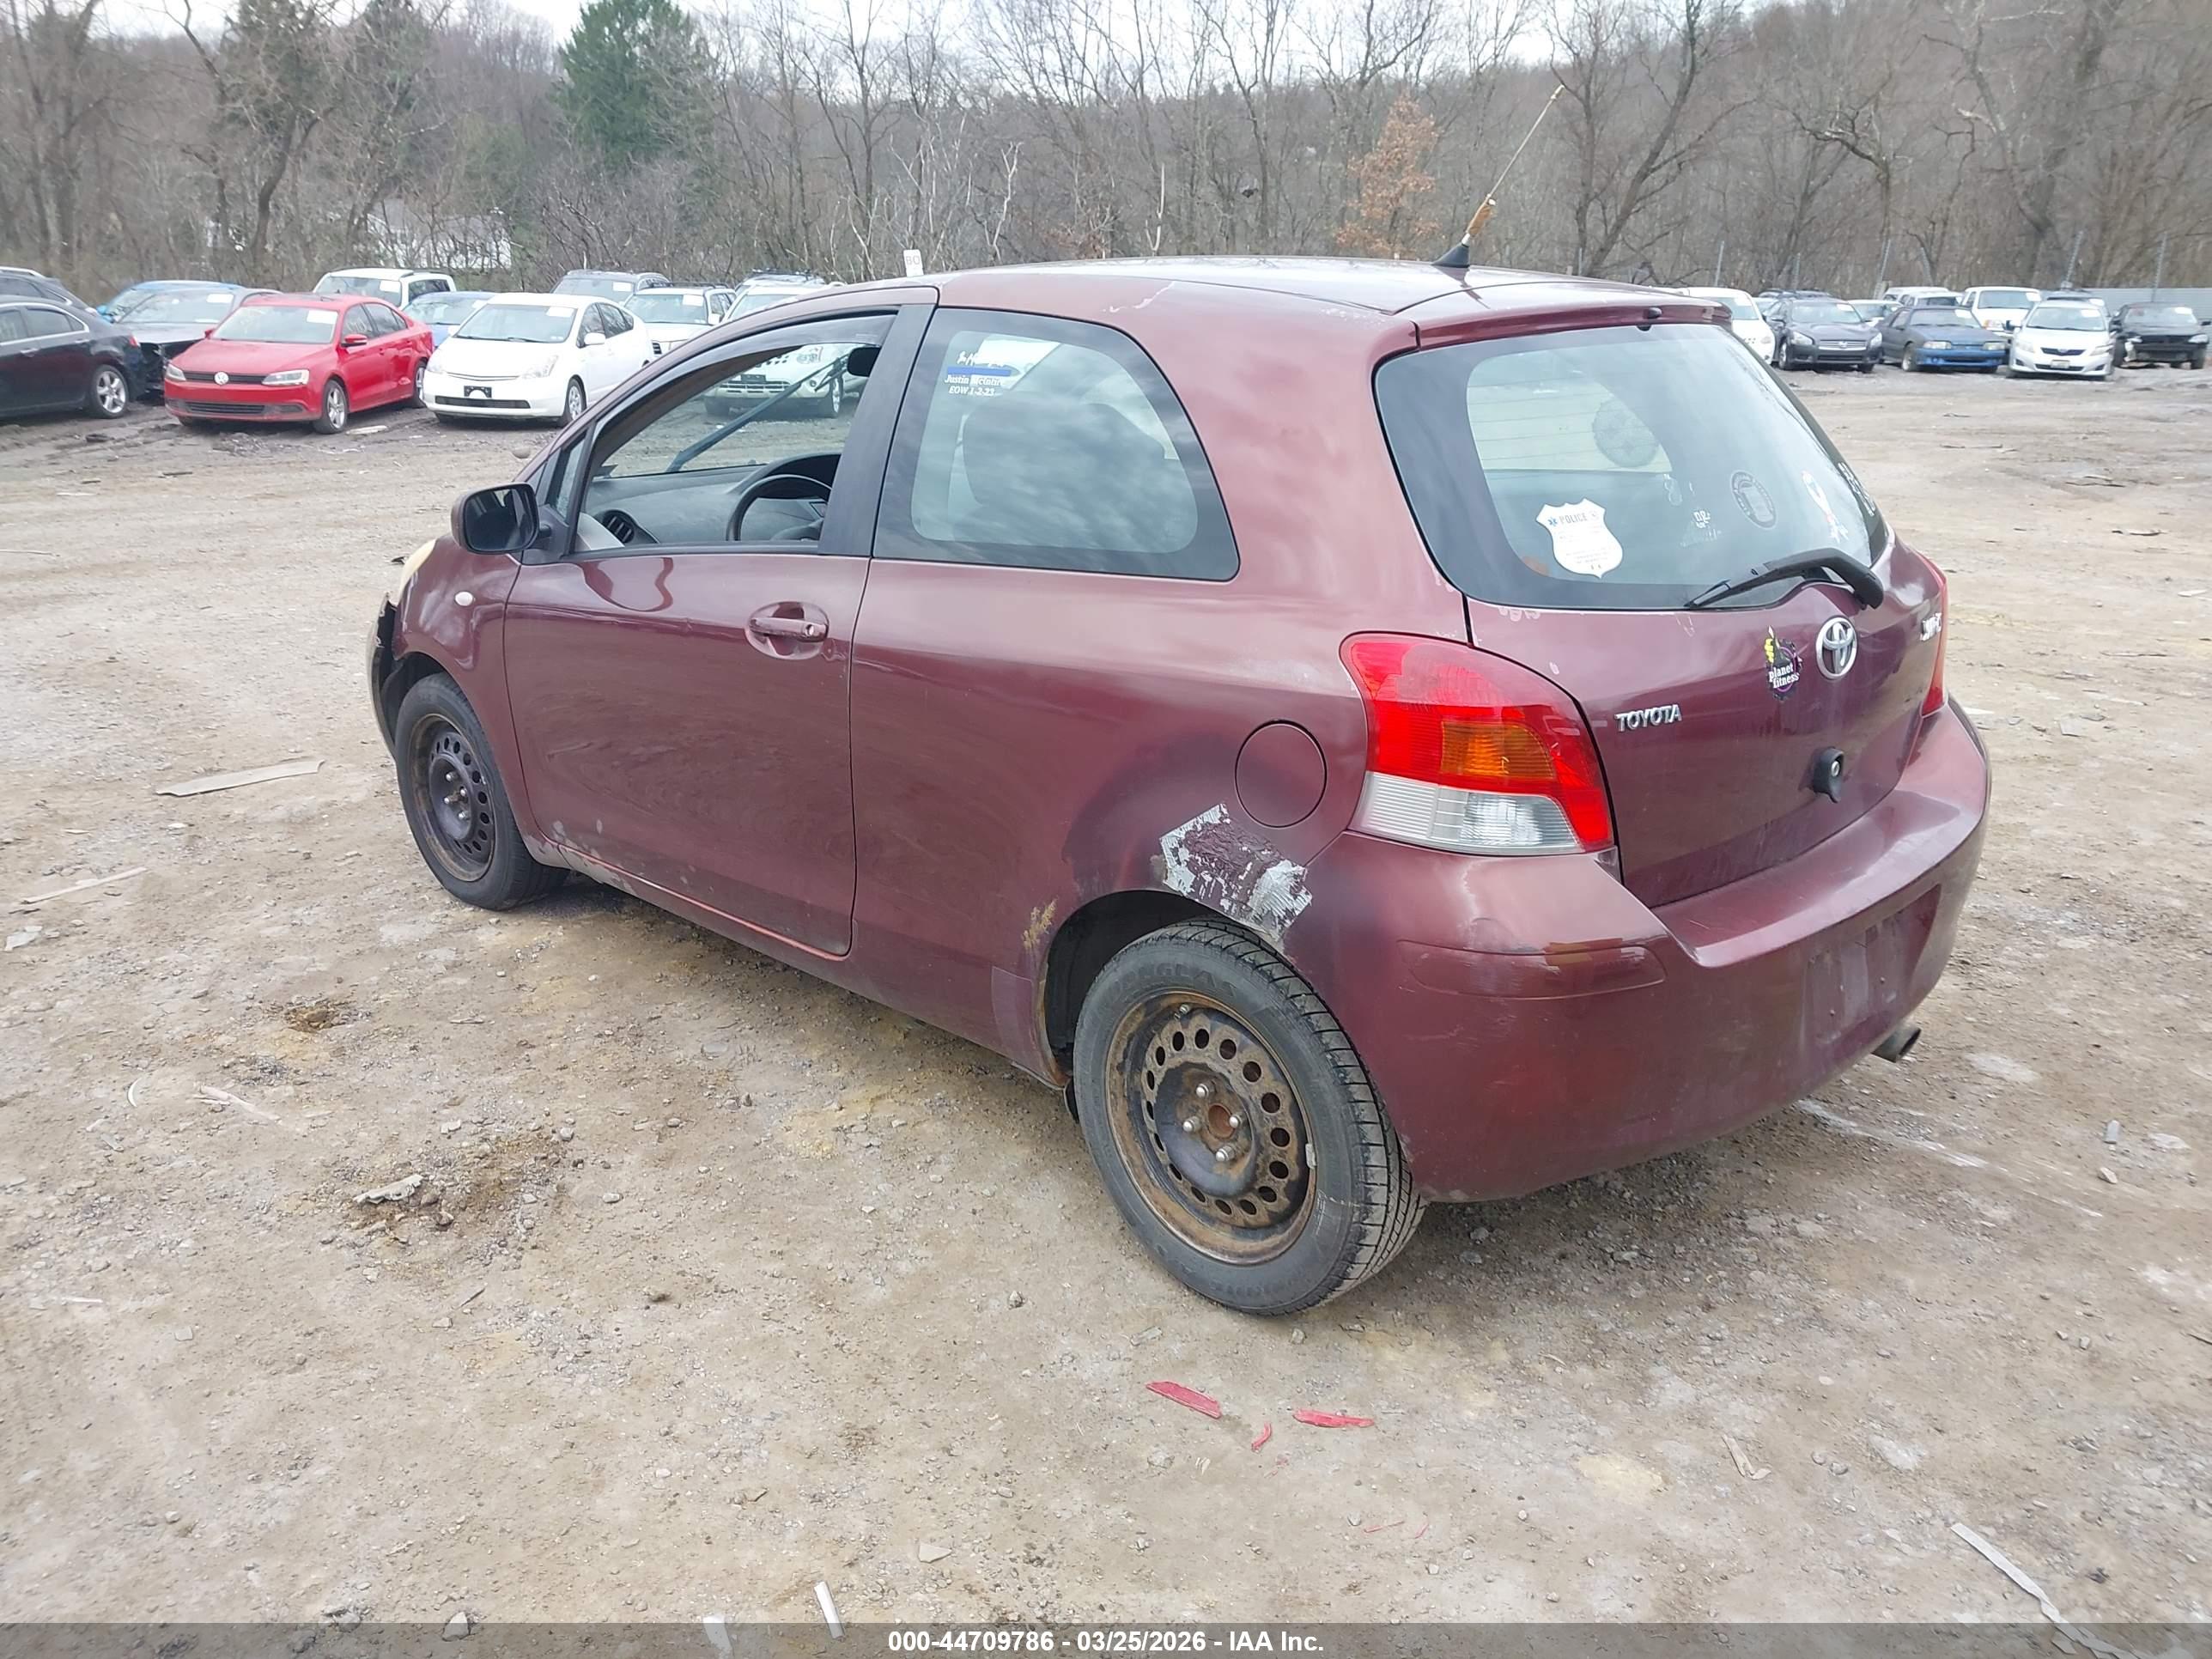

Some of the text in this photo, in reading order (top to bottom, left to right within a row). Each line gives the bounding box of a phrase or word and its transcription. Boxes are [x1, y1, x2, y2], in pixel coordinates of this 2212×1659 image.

[945, 374, 969, 385] Justin
[949, 386, 969, 395] EOW
[1559, 513, 1588, 525] POLICE
[1769, 662, 1794, 683] planet
[1773, 673, 1800, 689] fitness
[1614, 704, 1682, 732] TOYOTA
